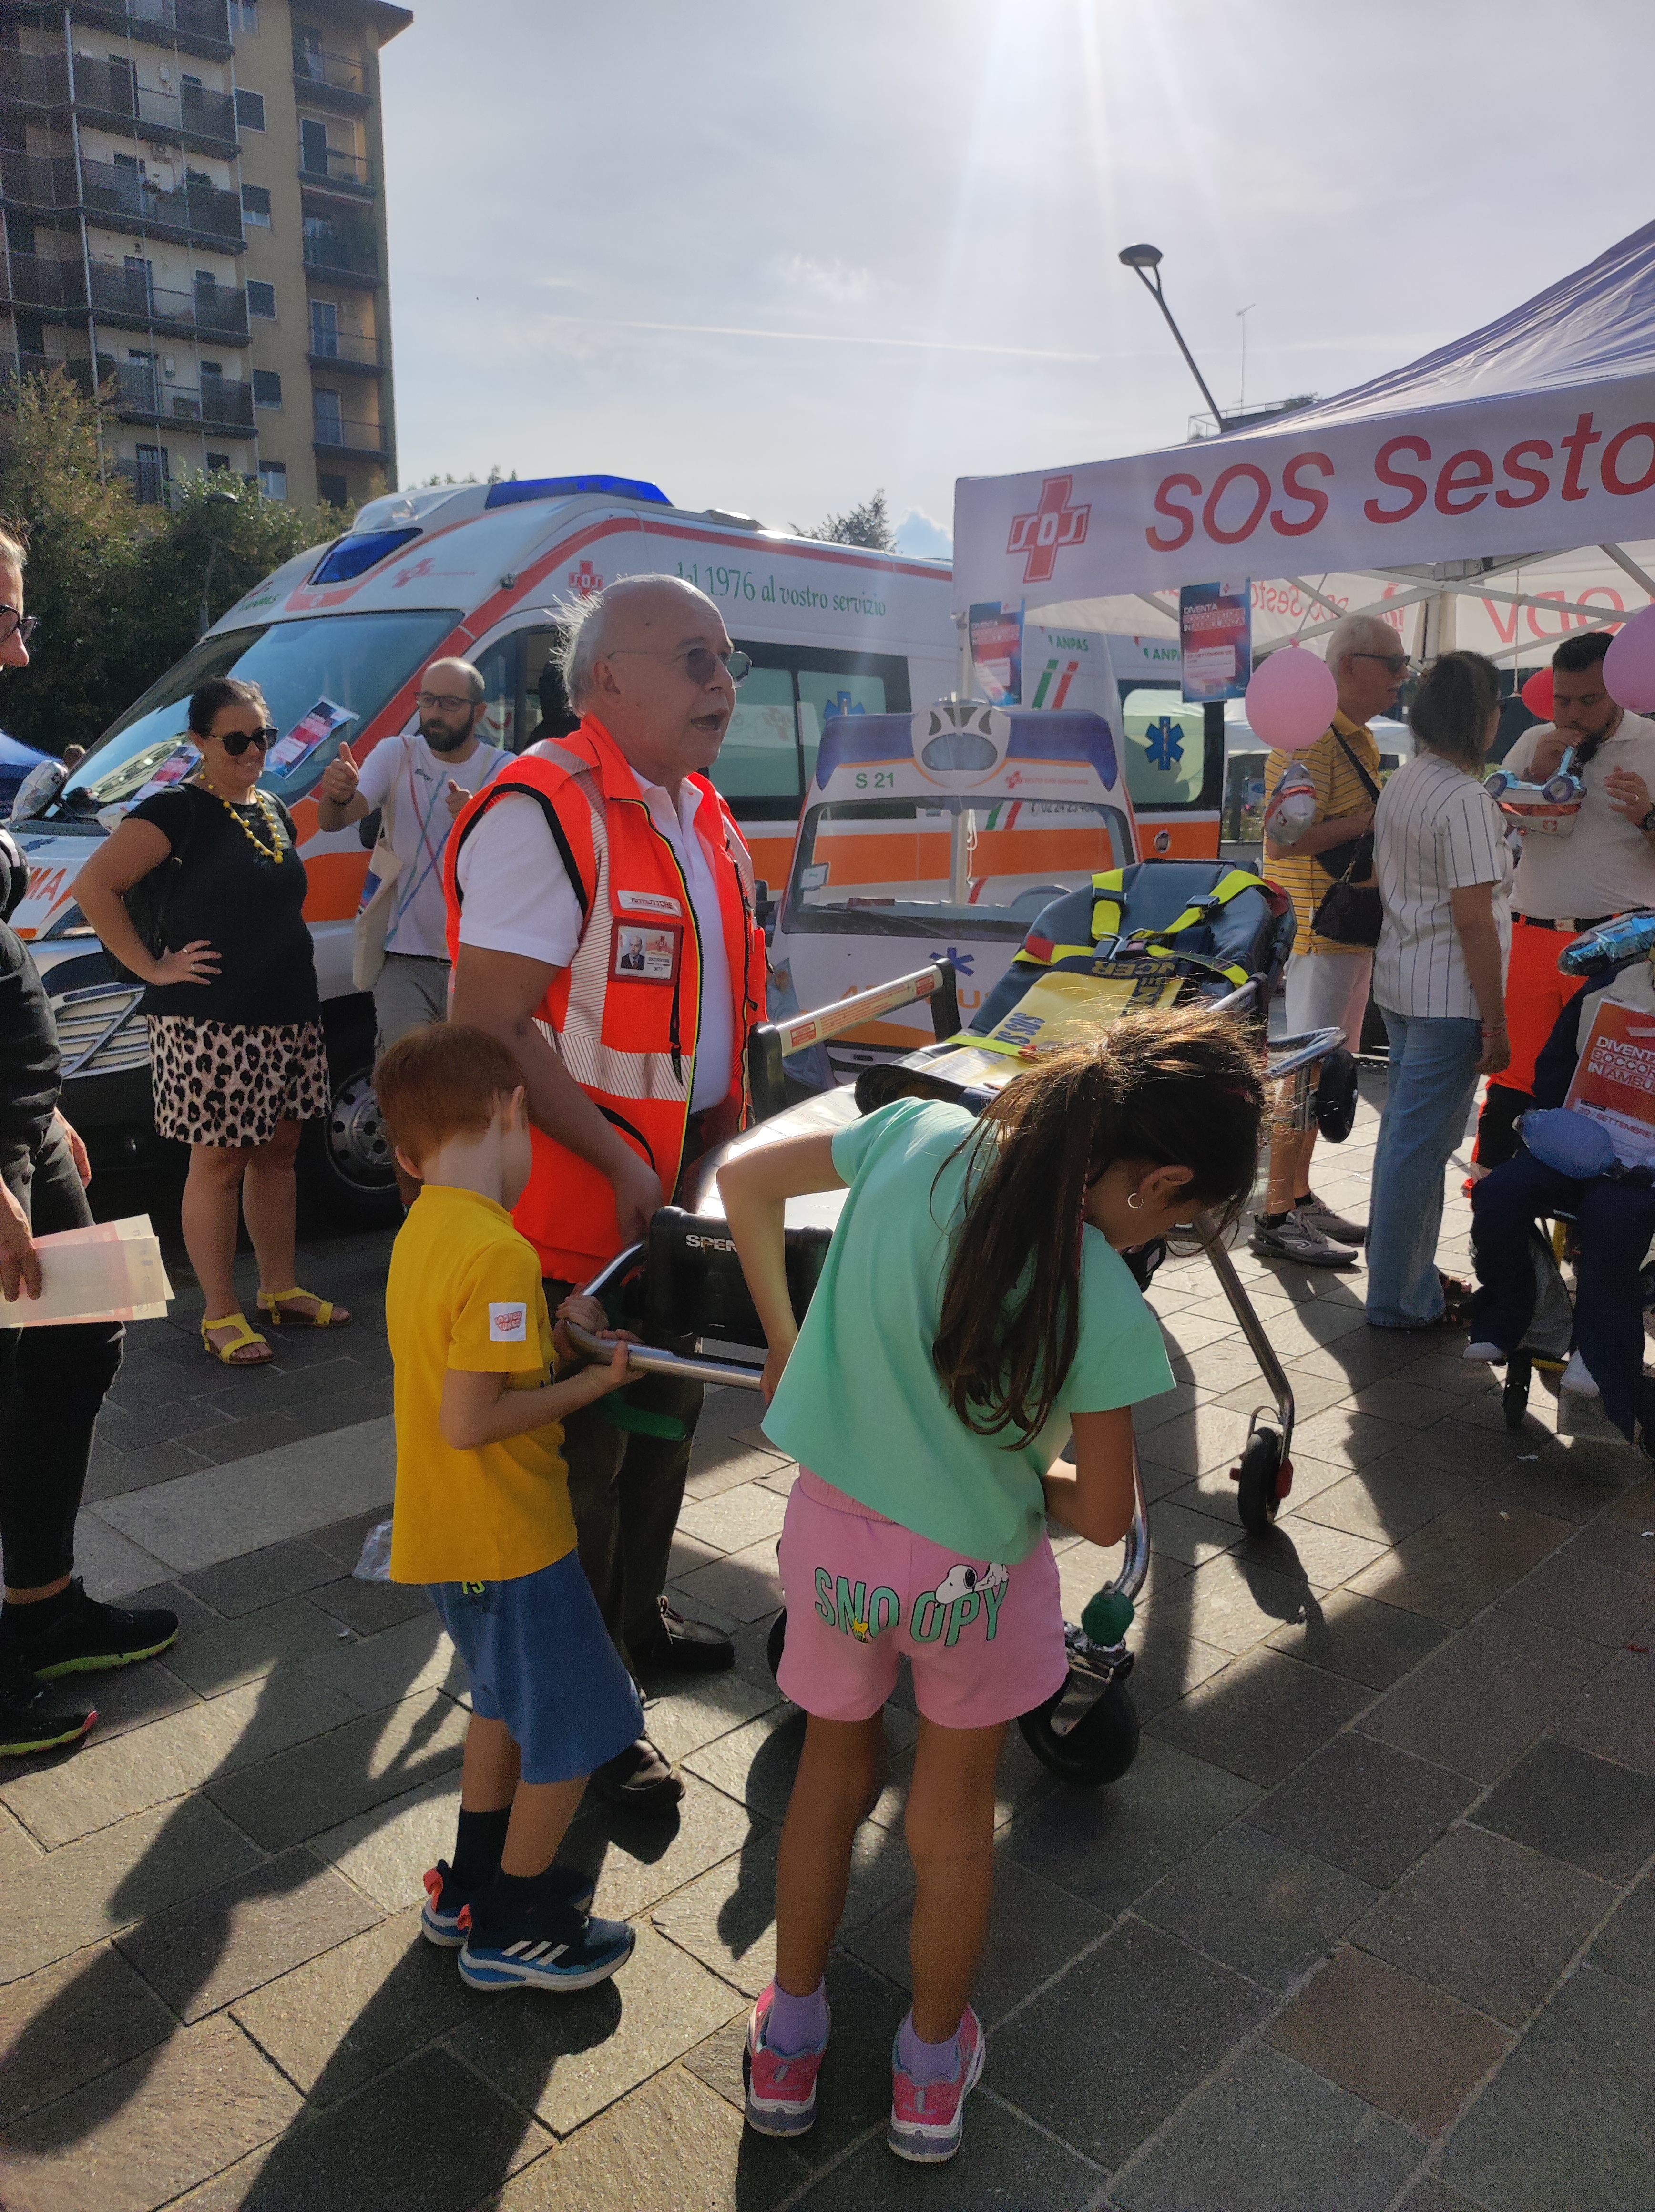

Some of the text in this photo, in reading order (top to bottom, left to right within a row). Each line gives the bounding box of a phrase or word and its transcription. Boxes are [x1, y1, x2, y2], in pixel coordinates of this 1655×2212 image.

[1145, 412, 1655, 552] SOS Sesto
[1009, 507, 1090, 551] SOS
[570, 573, 603, 590] SOS
[705, 566, 756, 601] 1976
[762, 575, 776, 603] al
[779, 585, 828, 609] vostro
[833, 592, 886, 616] servizio
[1183, 603, 1218, 615] DIVENTA
[1056, 635, 1089, 652] ANPAS
[856, 772, 894, 789] S 21
[25, 867, 67, 901] MA
[1588, 1061, 1604, 1075] IN
[686, 1234, 737, 1253] SPEN
